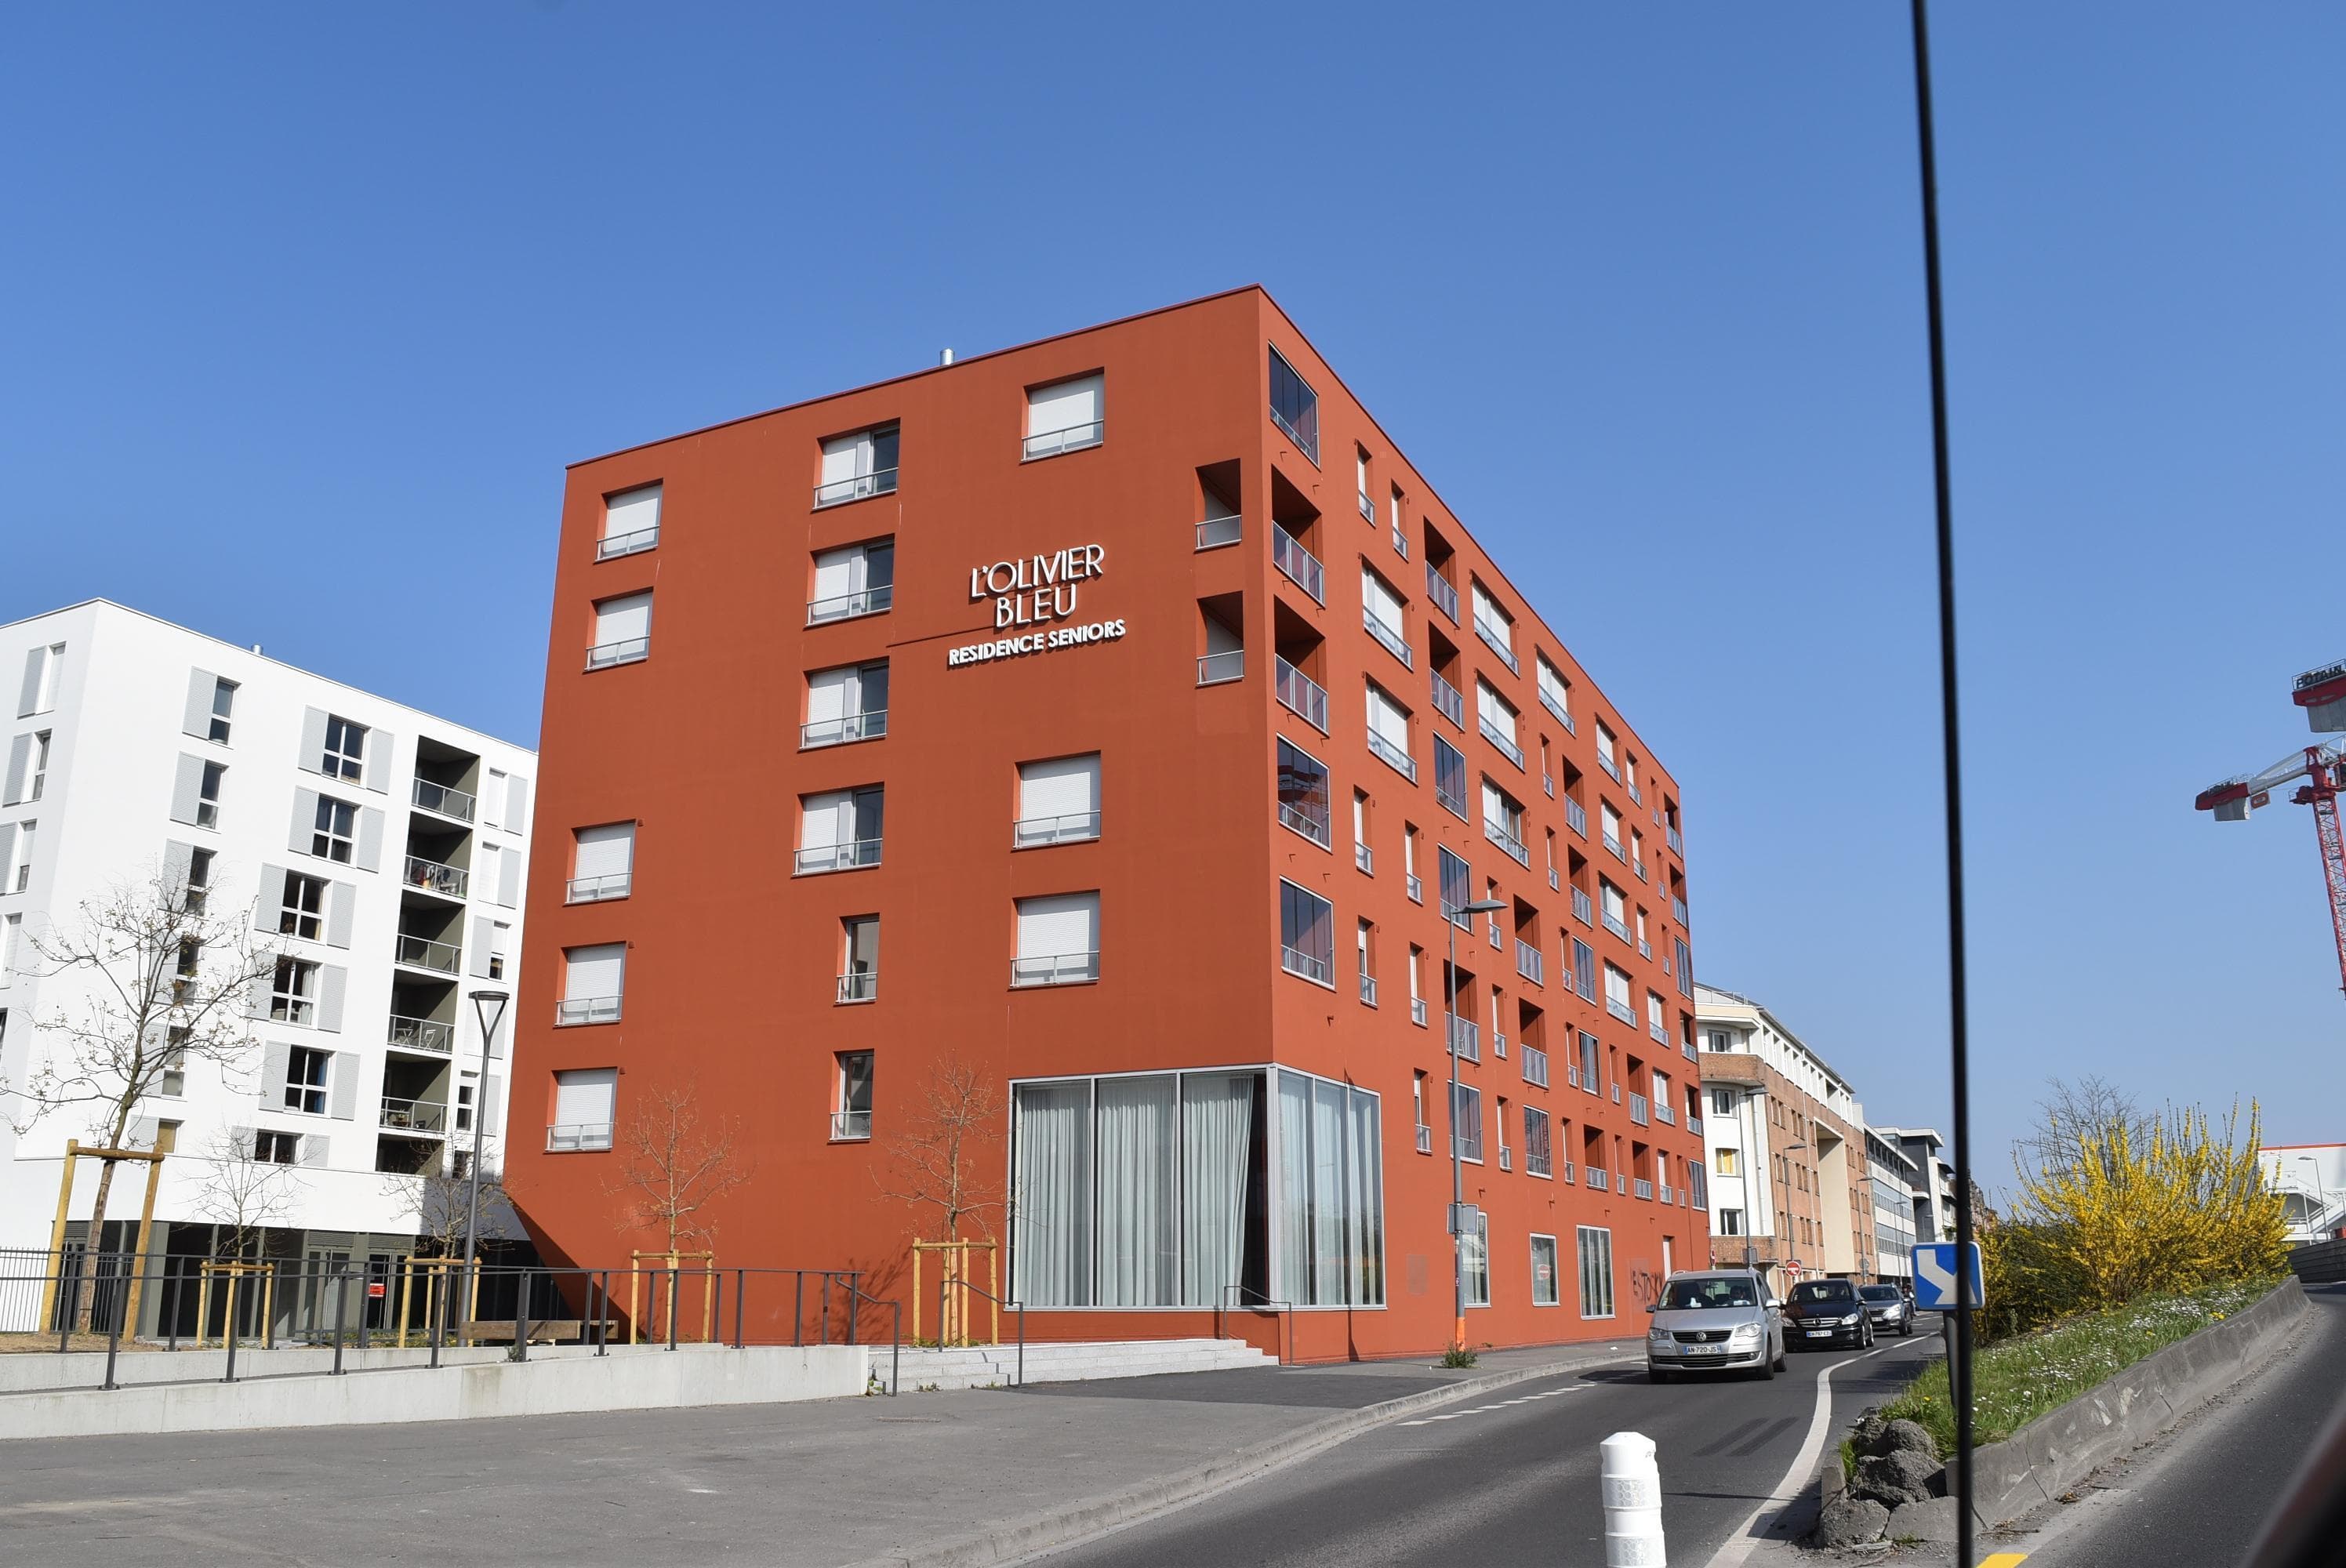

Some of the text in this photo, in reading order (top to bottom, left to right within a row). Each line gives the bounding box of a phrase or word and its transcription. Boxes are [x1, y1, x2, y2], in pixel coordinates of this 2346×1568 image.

[971, 544, 1105, 599] L'OLIVIER
[995, 583, 1077, 629] BLEU
[948, 619, 1127, 666] RESIDENCE SENIORS
[2297, 664, 2343, 689] POTAIN
